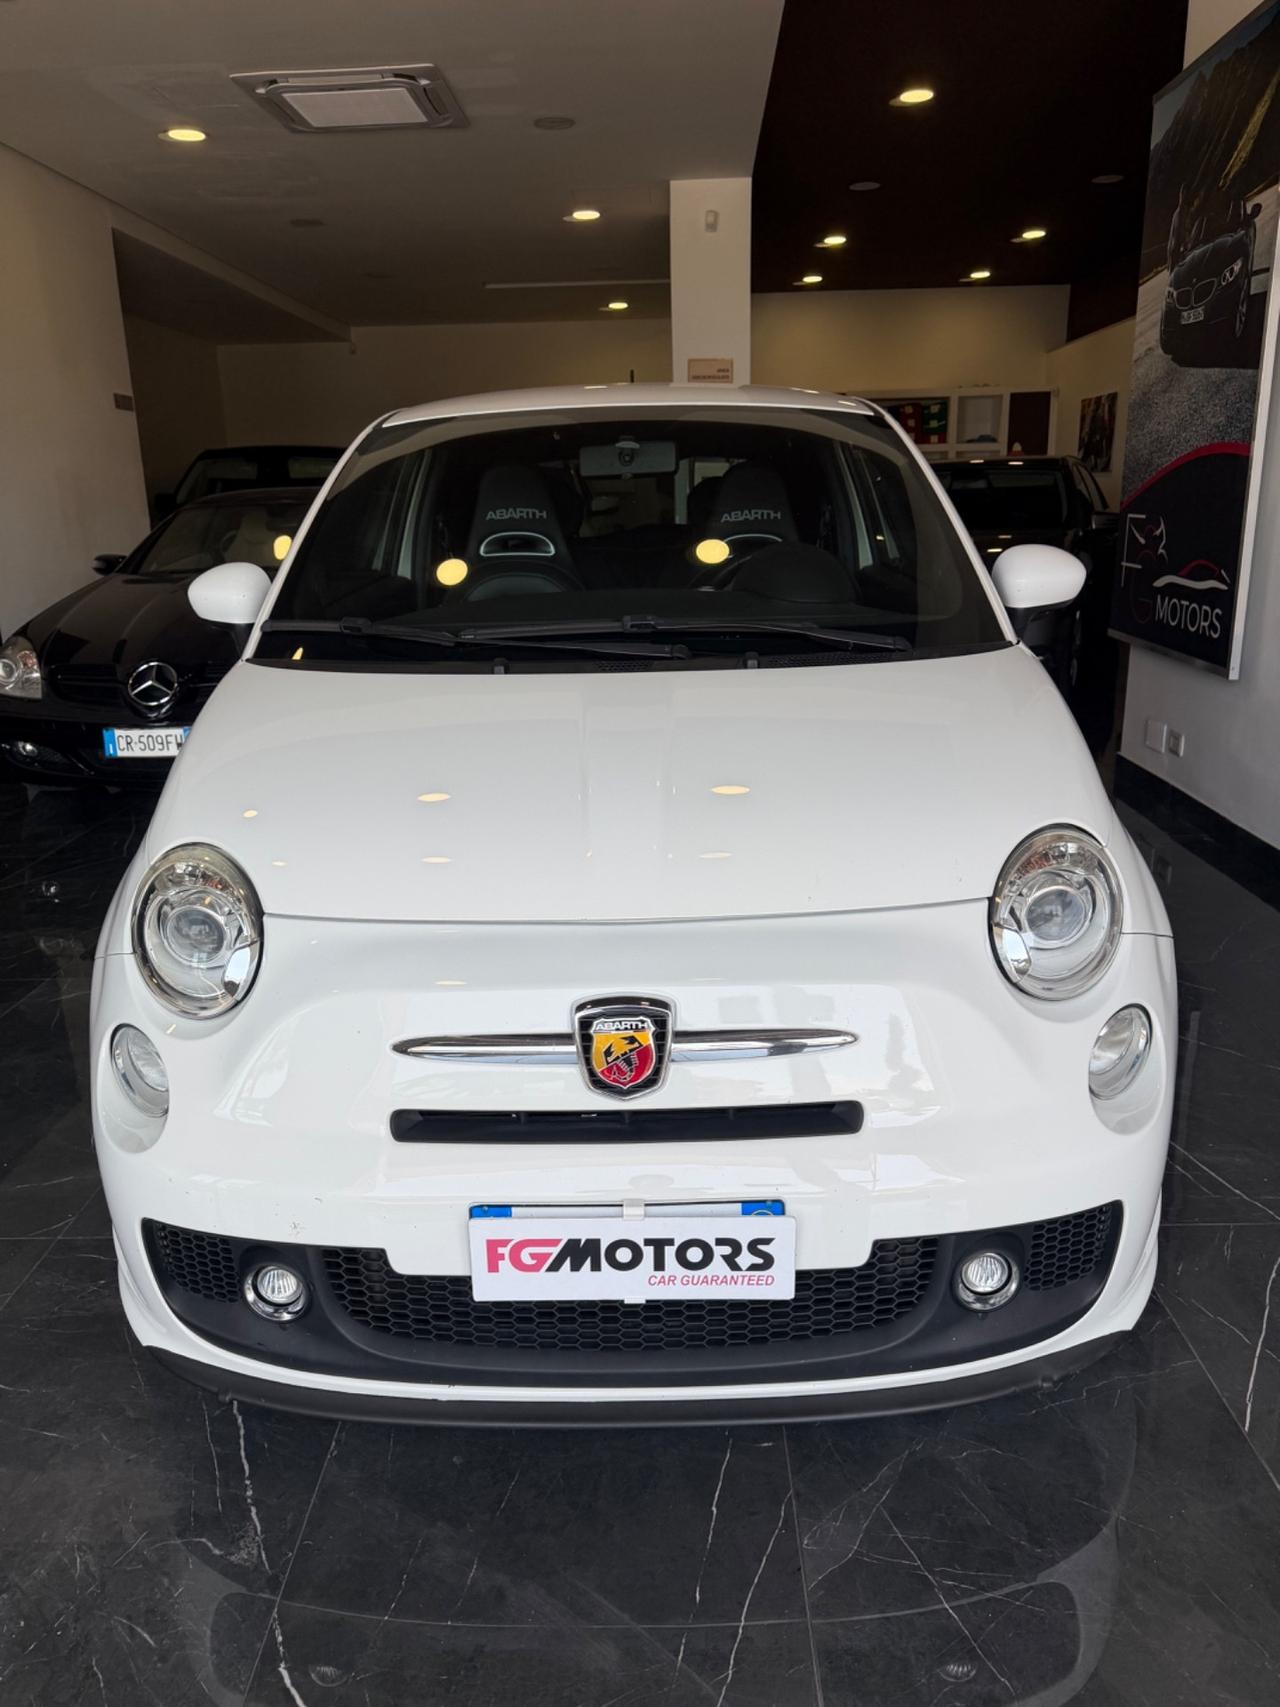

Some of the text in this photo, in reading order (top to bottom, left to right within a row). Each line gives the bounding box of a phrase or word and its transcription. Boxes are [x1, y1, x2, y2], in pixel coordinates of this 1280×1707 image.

[486, 508, 547, 520] ABARTH
[720, 509, 781, 523] ABARTH
[1155, 594, 1222, 639] MOTORS
[595, 1021, 648, 1031] ABARTH
[648, 1274, 775, 1286] CAR GUARANTEED
